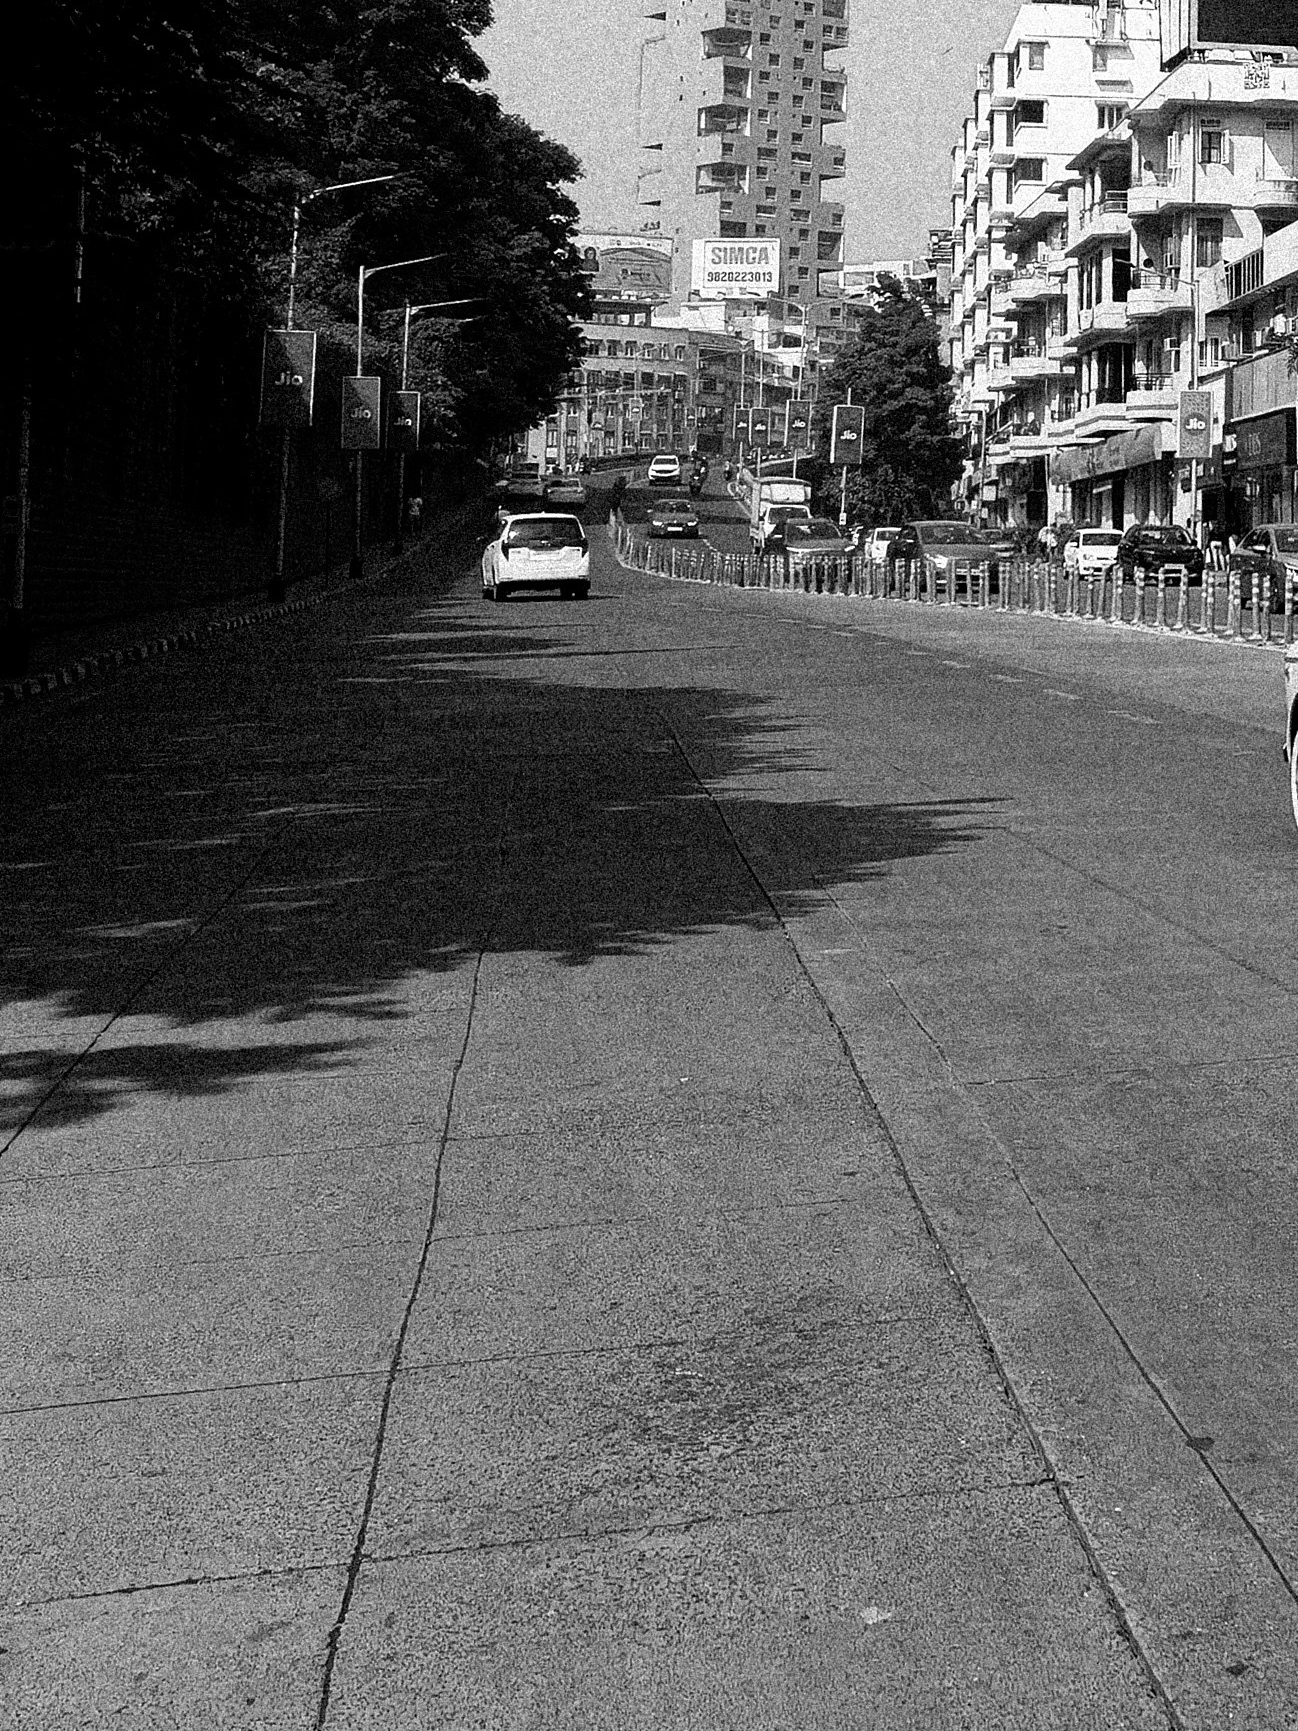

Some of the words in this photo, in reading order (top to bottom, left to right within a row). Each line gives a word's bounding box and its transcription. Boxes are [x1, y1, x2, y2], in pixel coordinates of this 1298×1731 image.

[711, 247, 769, 265] SIMCA
[707, 271, 773, 283] 9820223013
[275, 371, 303, 386] Jio
[350, 406, 371, 419] Jio
[1185, 417, 1206, 430] Jio
[840, 430, 857, 440] Jio
